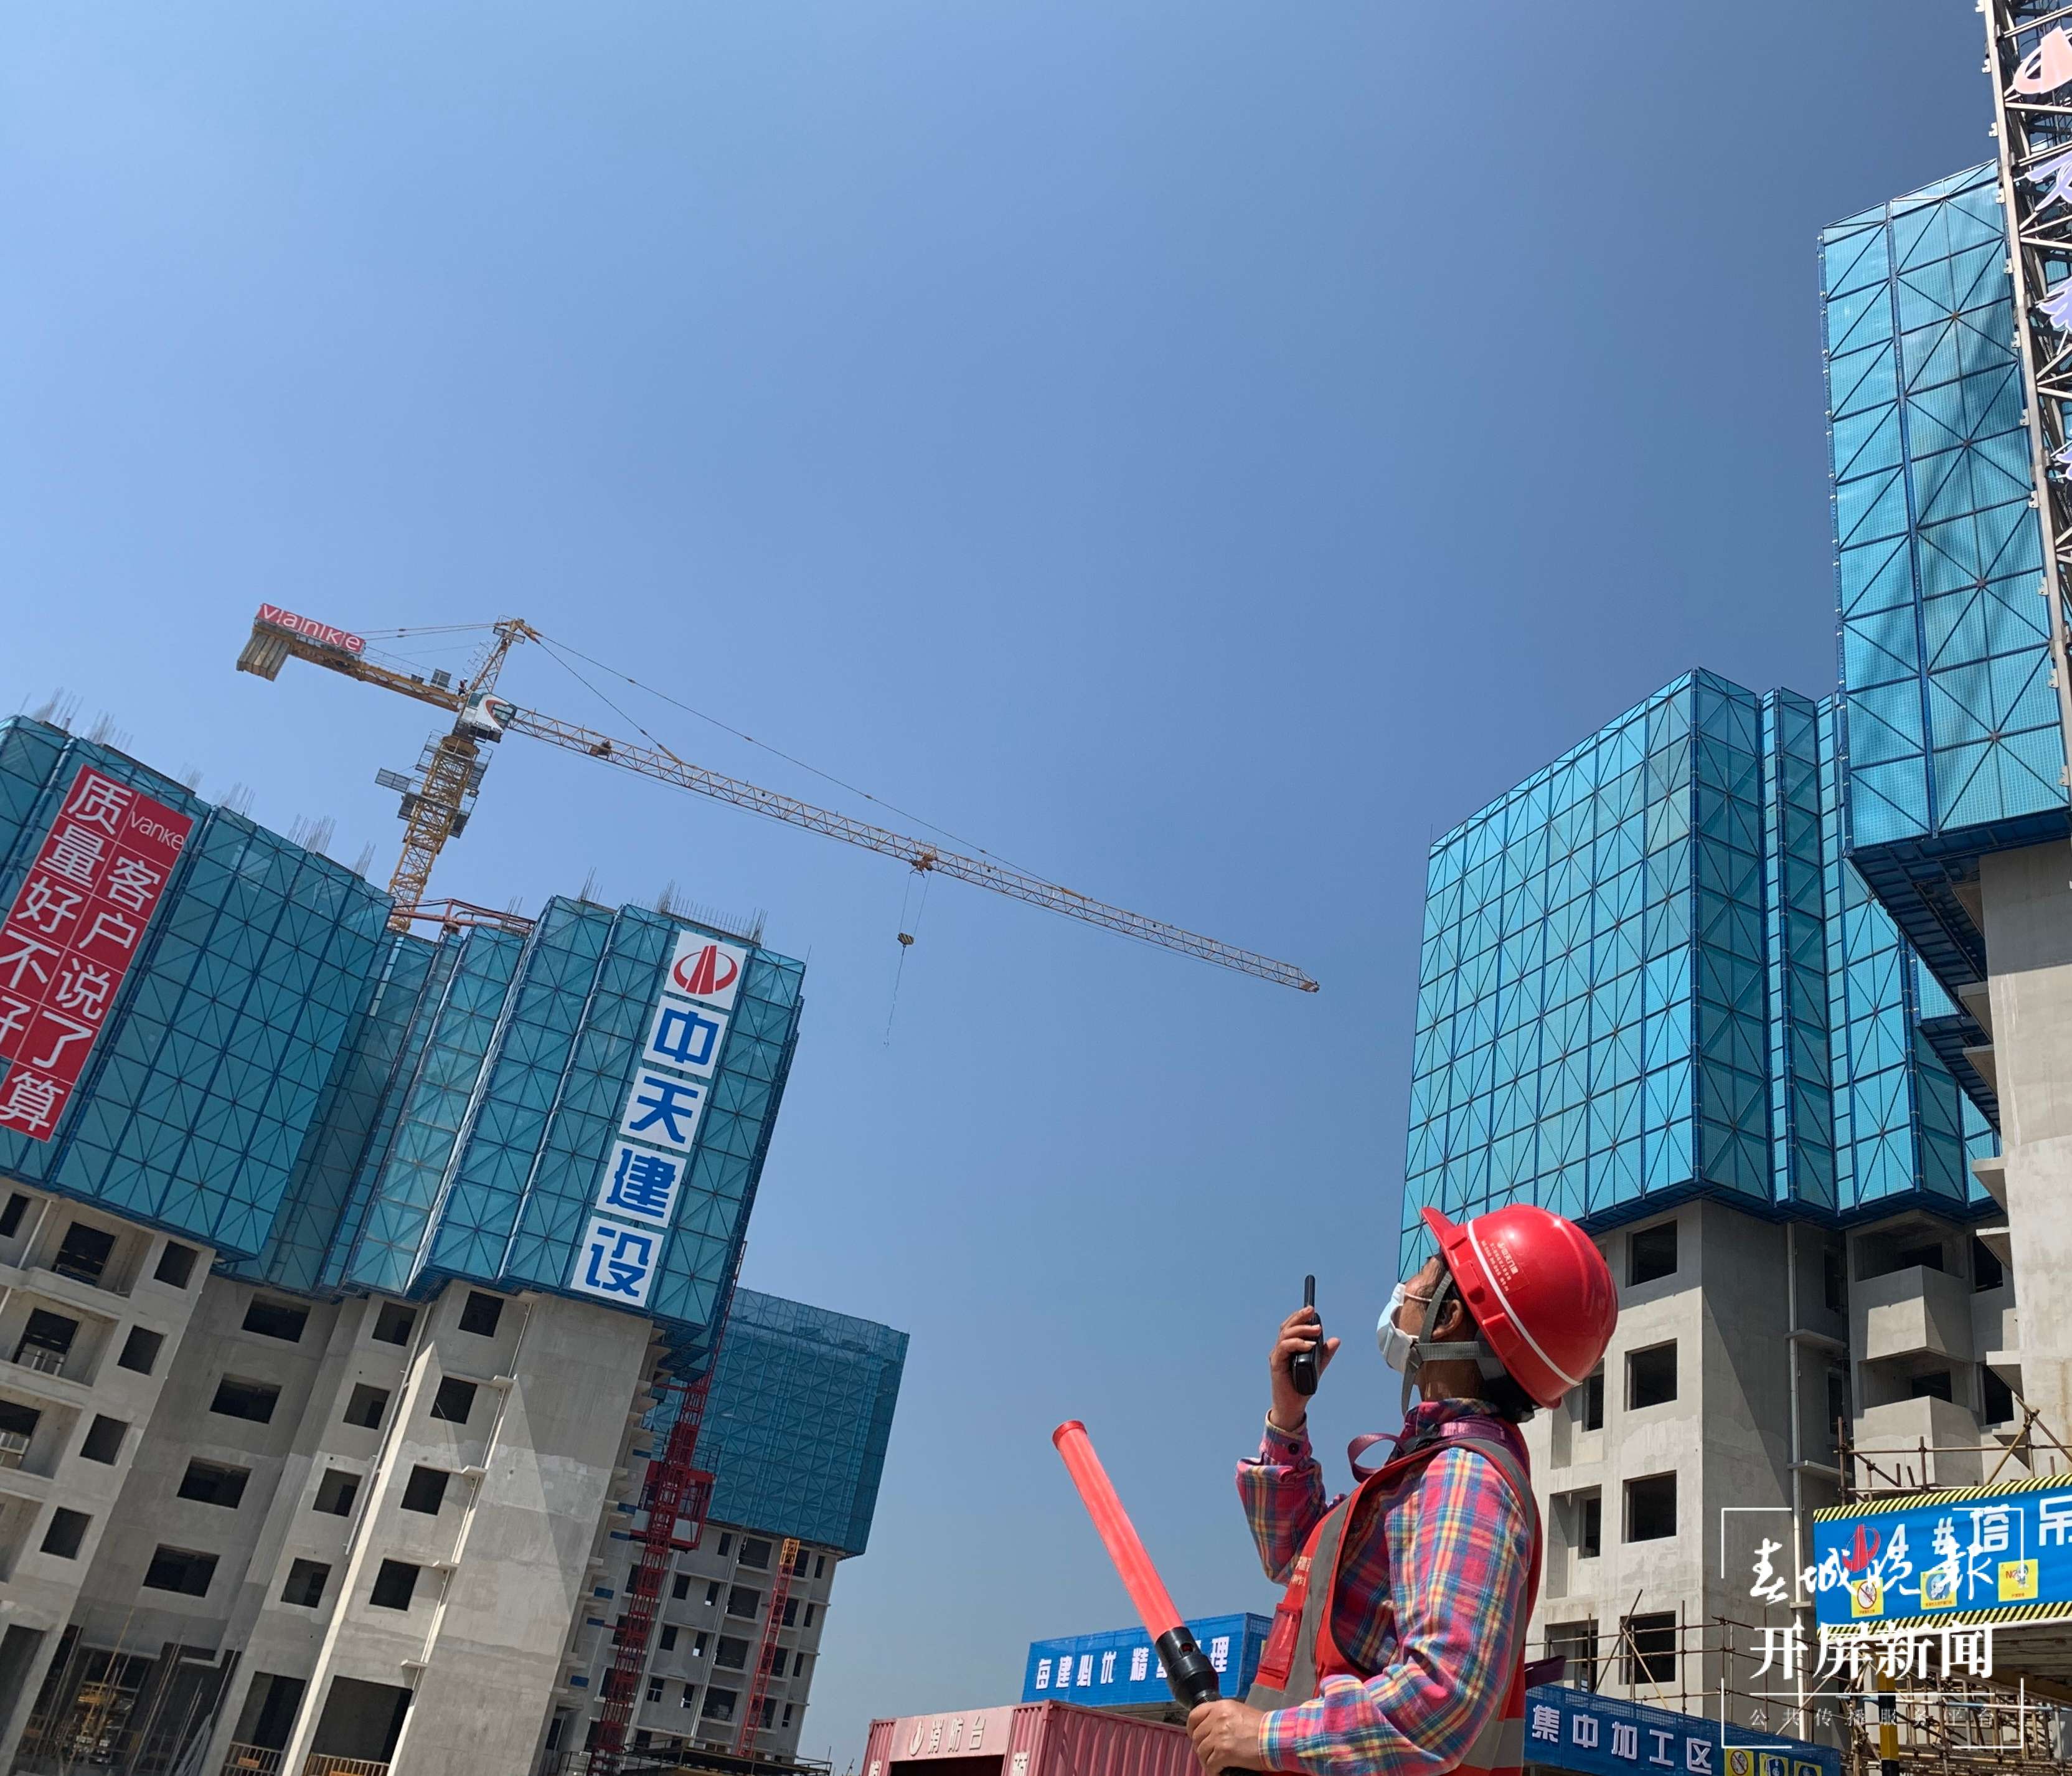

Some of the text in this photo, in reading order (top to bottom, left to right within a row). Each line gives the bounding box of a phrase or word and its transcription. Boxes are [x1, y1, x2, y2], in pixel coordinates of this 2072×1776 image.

[262, 605, 361, 650] vanke
[131, 811, 184, 851] vanke
[0, 859, 161, 1131] 客户说了算
[585, 1011, 719, 1297] 中天建设
[1129, 1637, 1229, 1681] 精理
[1532, 1704, 1712, 1775] 集中加工区
